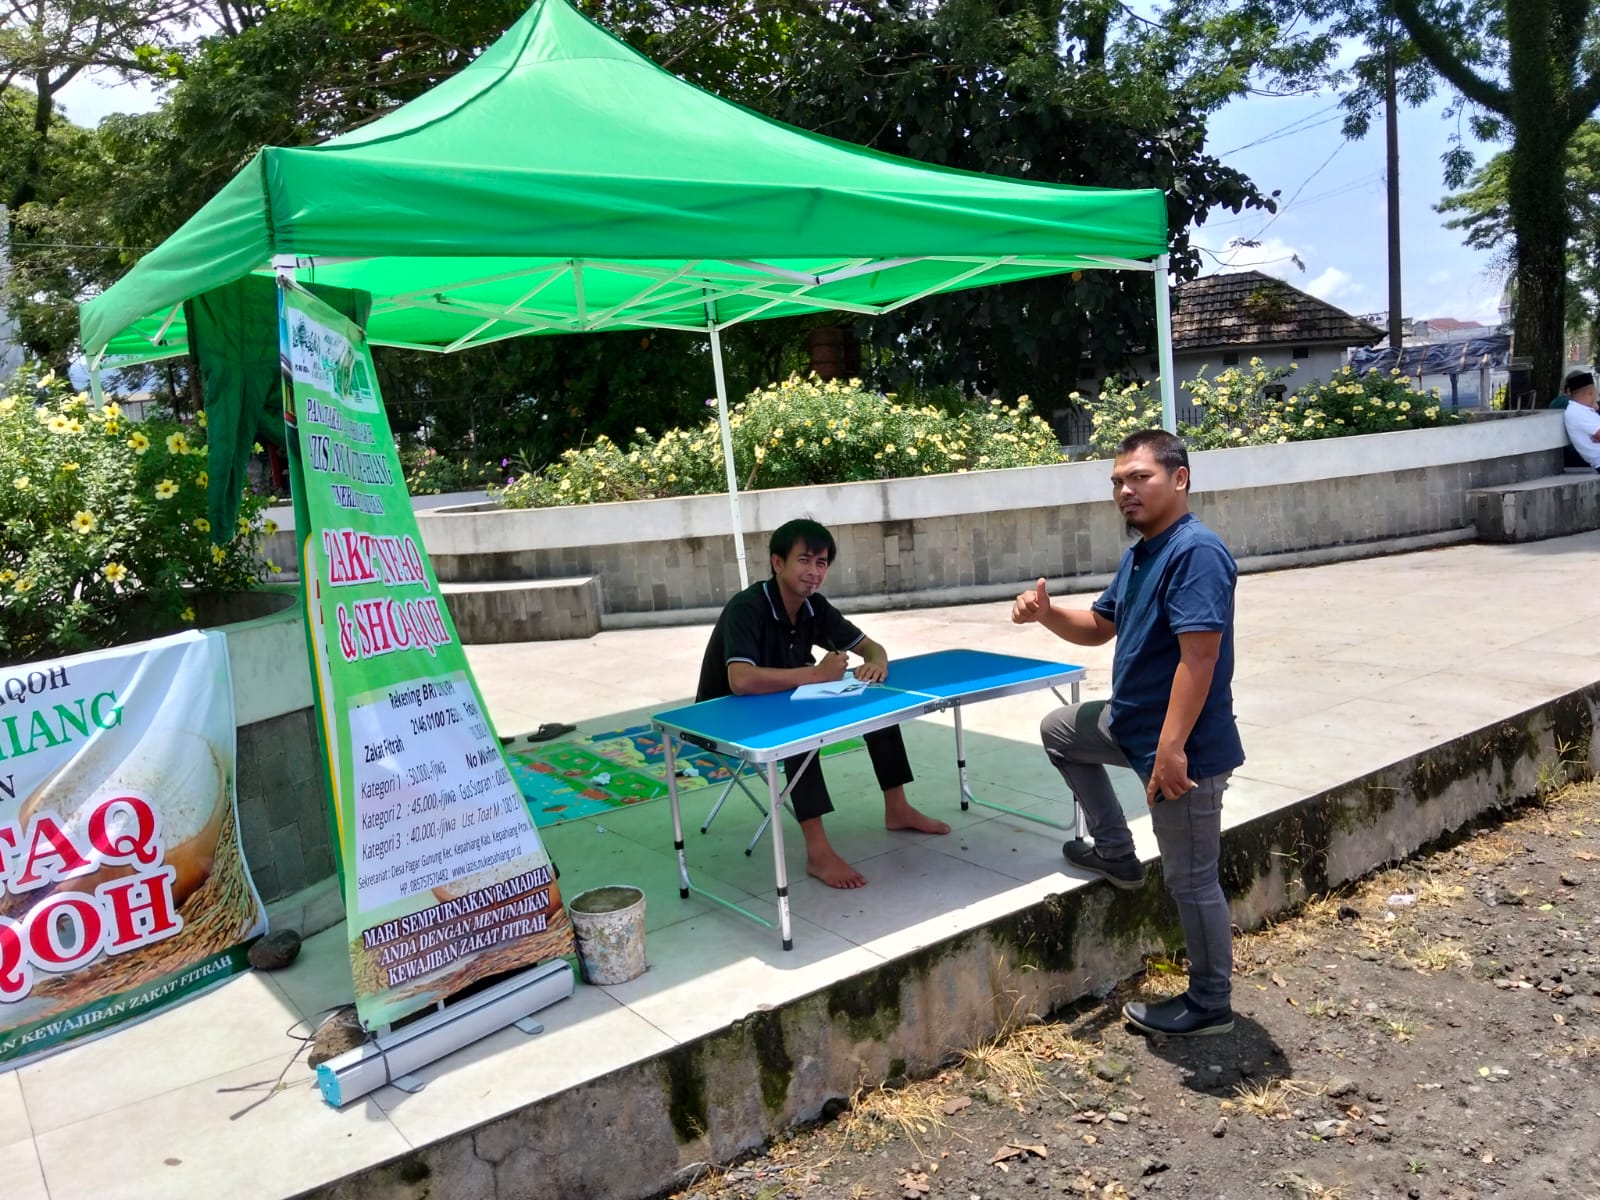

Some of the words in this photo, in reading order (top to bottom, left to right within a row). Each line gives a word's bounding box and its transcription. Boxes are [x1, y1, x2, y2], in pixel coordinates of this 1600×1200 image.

[338, 606, 357, 659] &
[389, 688, 422, 710] Rekening
[364, 742, 385, 764] Zakat
[384, 734, 405, 758] Fitrah
[466, 753, 478, 769] No
[361, 774, 395, 800] Kategori
[361, 803, 395, 830] Kategori
[396, 803, 402, 820] 2
[358, 869, 388, 890] Sekretariat
[391, 863, 405, 878] Desa
[406, 859, 420, 874] Pagar
[421, 851, 443, 867] Gunung
[454, 839, 480, 857] Kepahiang
[492, 825, 519, 842] Kepahiang
[361, 833, 395, 860] Kategori
[396, 833, 401, 850] 3
[363, 920, 399, 949] MARI
[402, 887, 494, 936] SEMPURNAKAN
[381, 939, 417, 966] ANDA
[420, 918, 472, 951] DENGAN
[473, 889, 550, 931] MENUNAIKAN
[388, 942, 458, 986] KEWAJIBAN
[460, 927, 500, 956] ZAKAT
[501, 913, 548, 941] FITRAH
[21, 1001, 126, 1045] KEWAJIBAN
[129, 980, 178, 1008] ZAKAT
[180, 955, 233, 987] FITRAH
